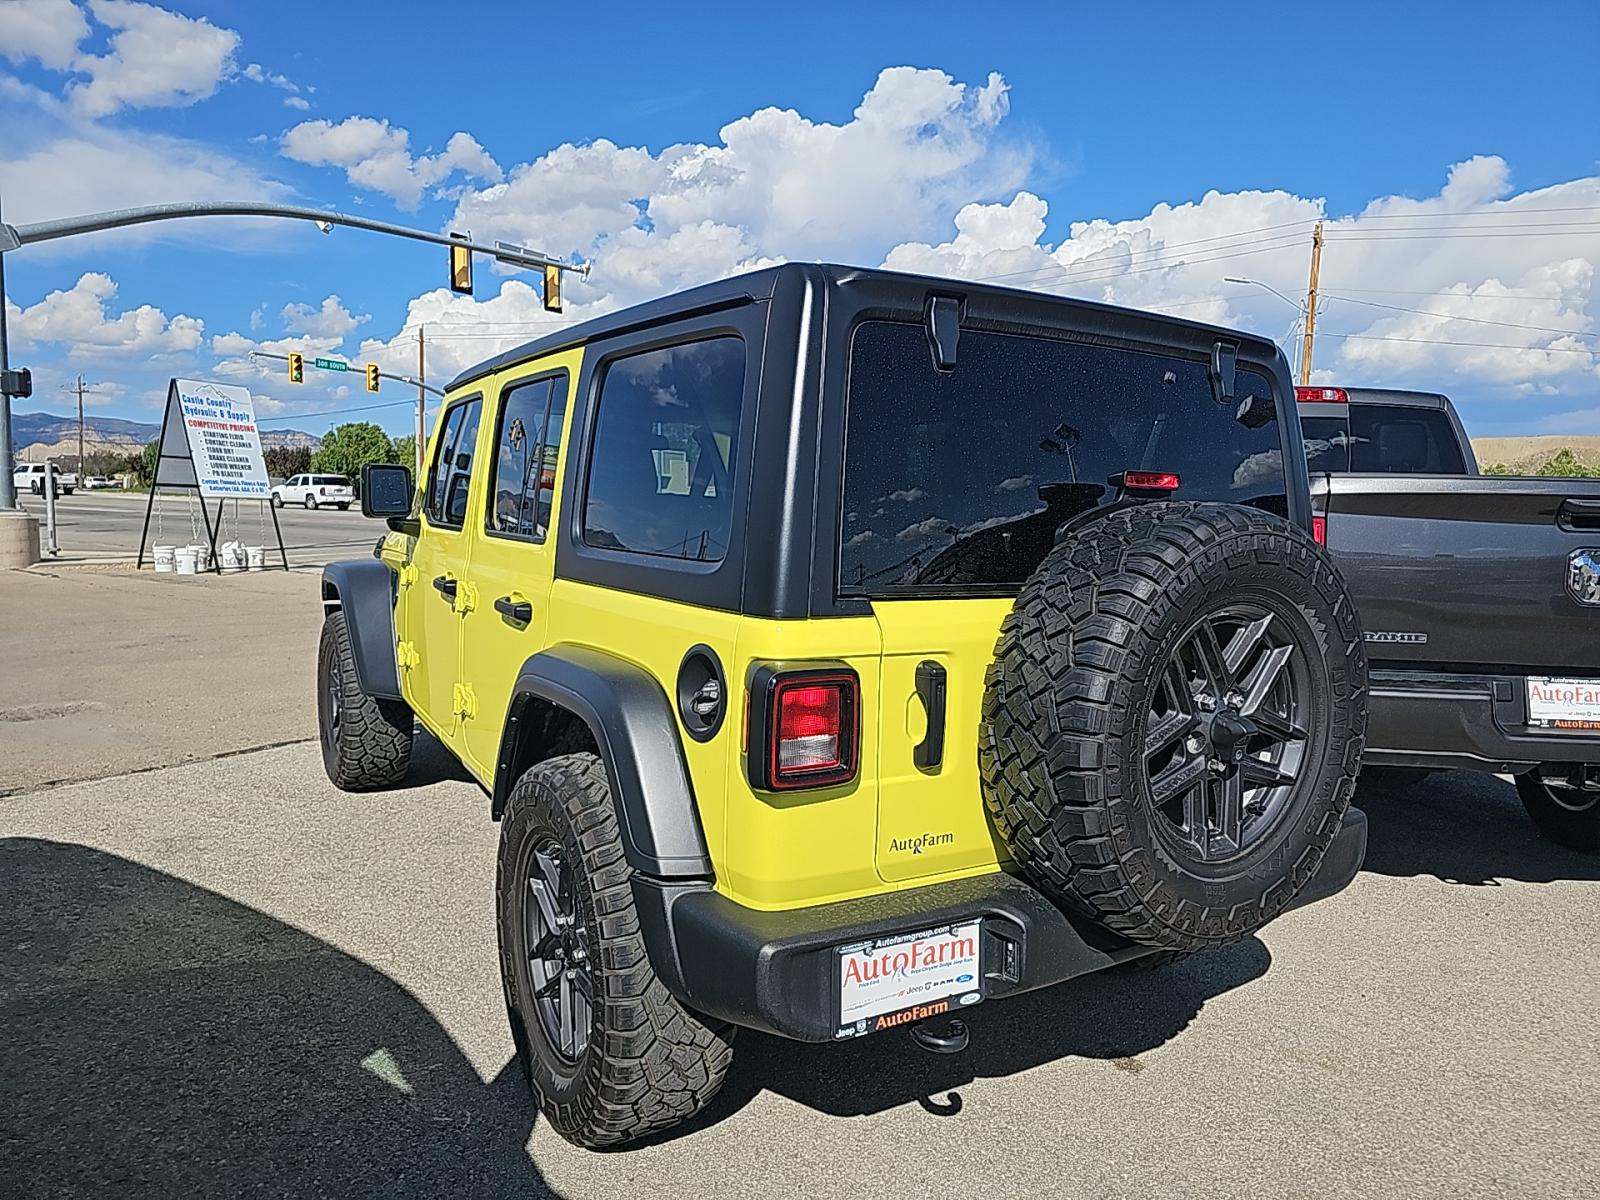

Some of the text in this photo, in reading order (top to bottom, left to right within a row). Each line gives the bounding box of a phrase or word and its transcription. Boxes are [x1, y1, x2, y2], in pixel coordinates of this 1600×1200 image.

[330, 361, 346, 370] SOUTH
[182, 394, 232, 409] Castle Country
[184, 406, 218, 418] Hydraulic
[226, 410, 250, 422] Supply
[188, 420, 255, 432] COMPETITIVE PRICING
[202, 430, 228, 440] STARTING
[205, 439, 228, 447] CONTACT
[1363, 631, 1428, 644] RAMIE
[1531, 685, 1600, 702] AutoFar
[888, 833, 954, 853] AutoFarm
[876, 926, 950, 948] Autofarmgroup.com
[843, 937, 976, 987] AutoFarm
[906, 978, 954, 994] Jeep RAM
[875, 1000, 949, 1030] AutoFarm
[836, 1027, 855, 1038] Jeep
